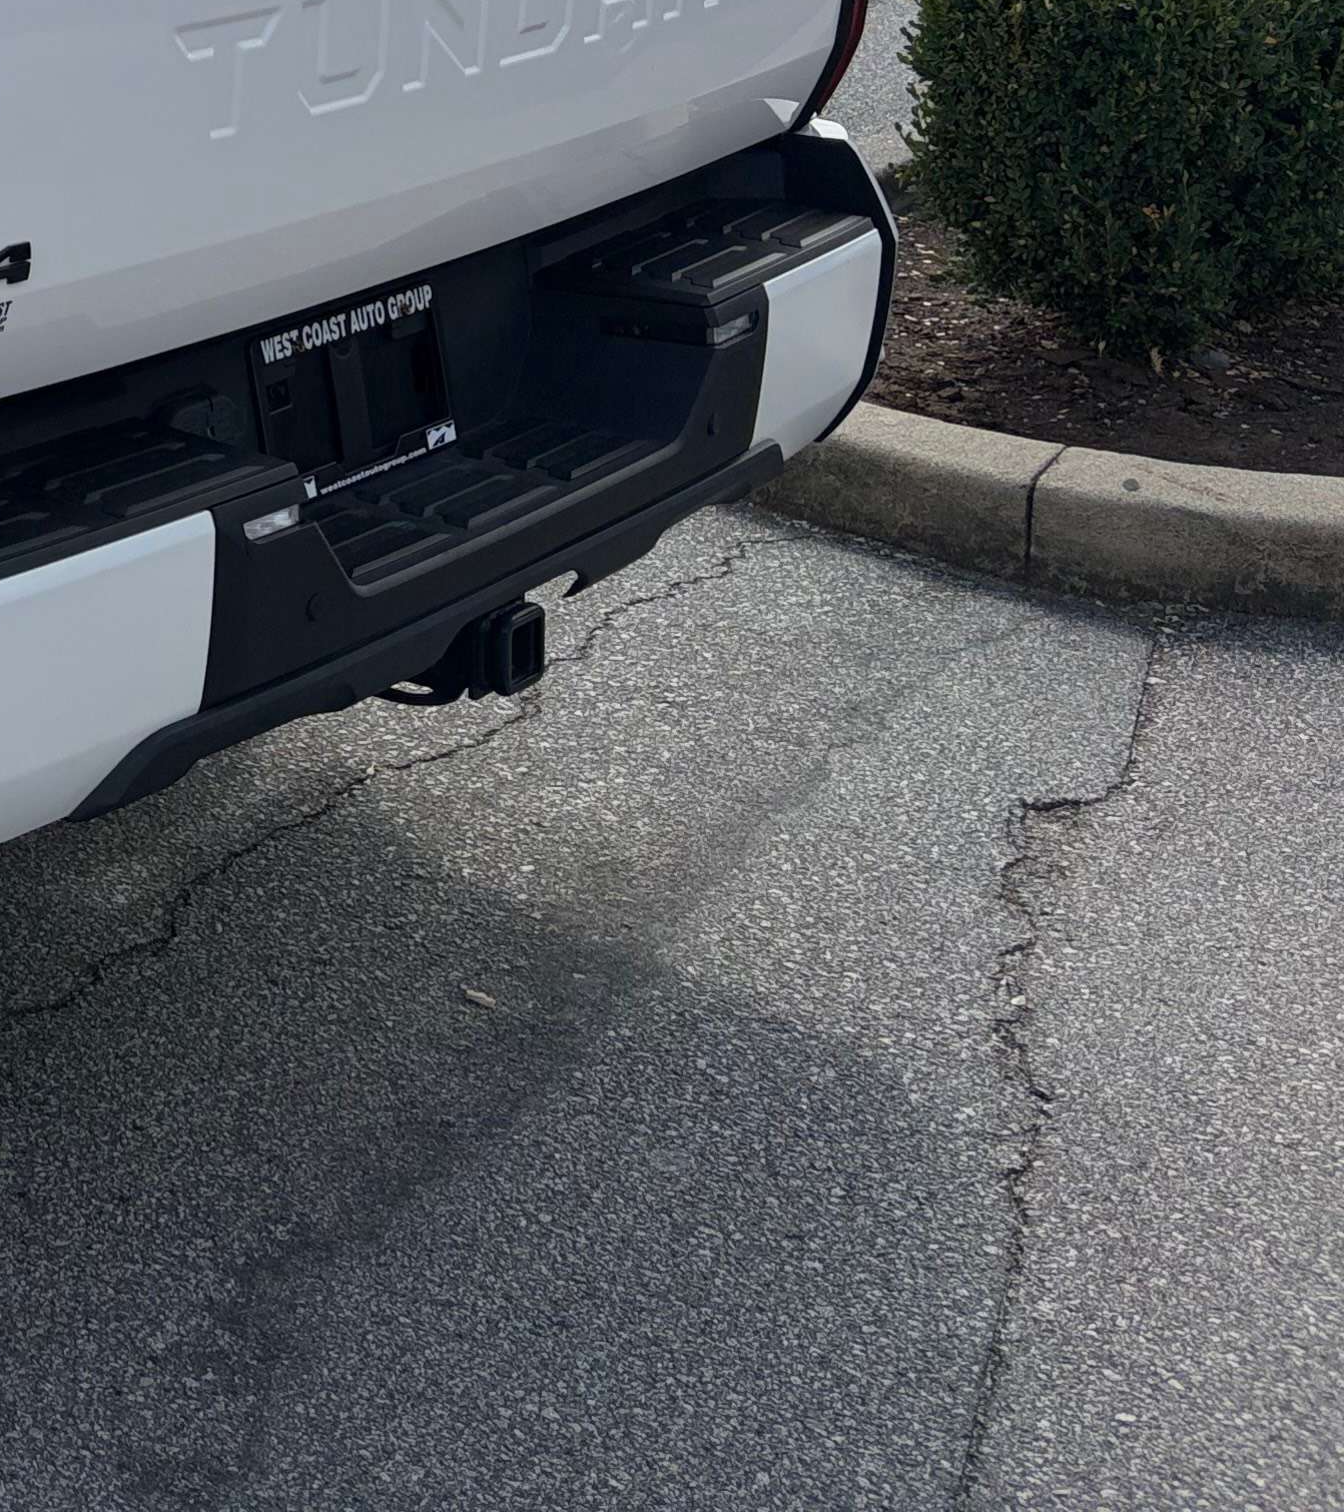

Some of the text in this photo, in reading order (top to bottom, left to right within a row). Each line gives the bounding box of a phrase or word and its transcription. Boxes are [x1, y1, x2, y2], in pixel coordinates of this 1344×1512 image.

[260, 285, 433, 364] WEST COAST AUTO GROUP
[320, 447, 427, 495] westcoastautogroup.com
